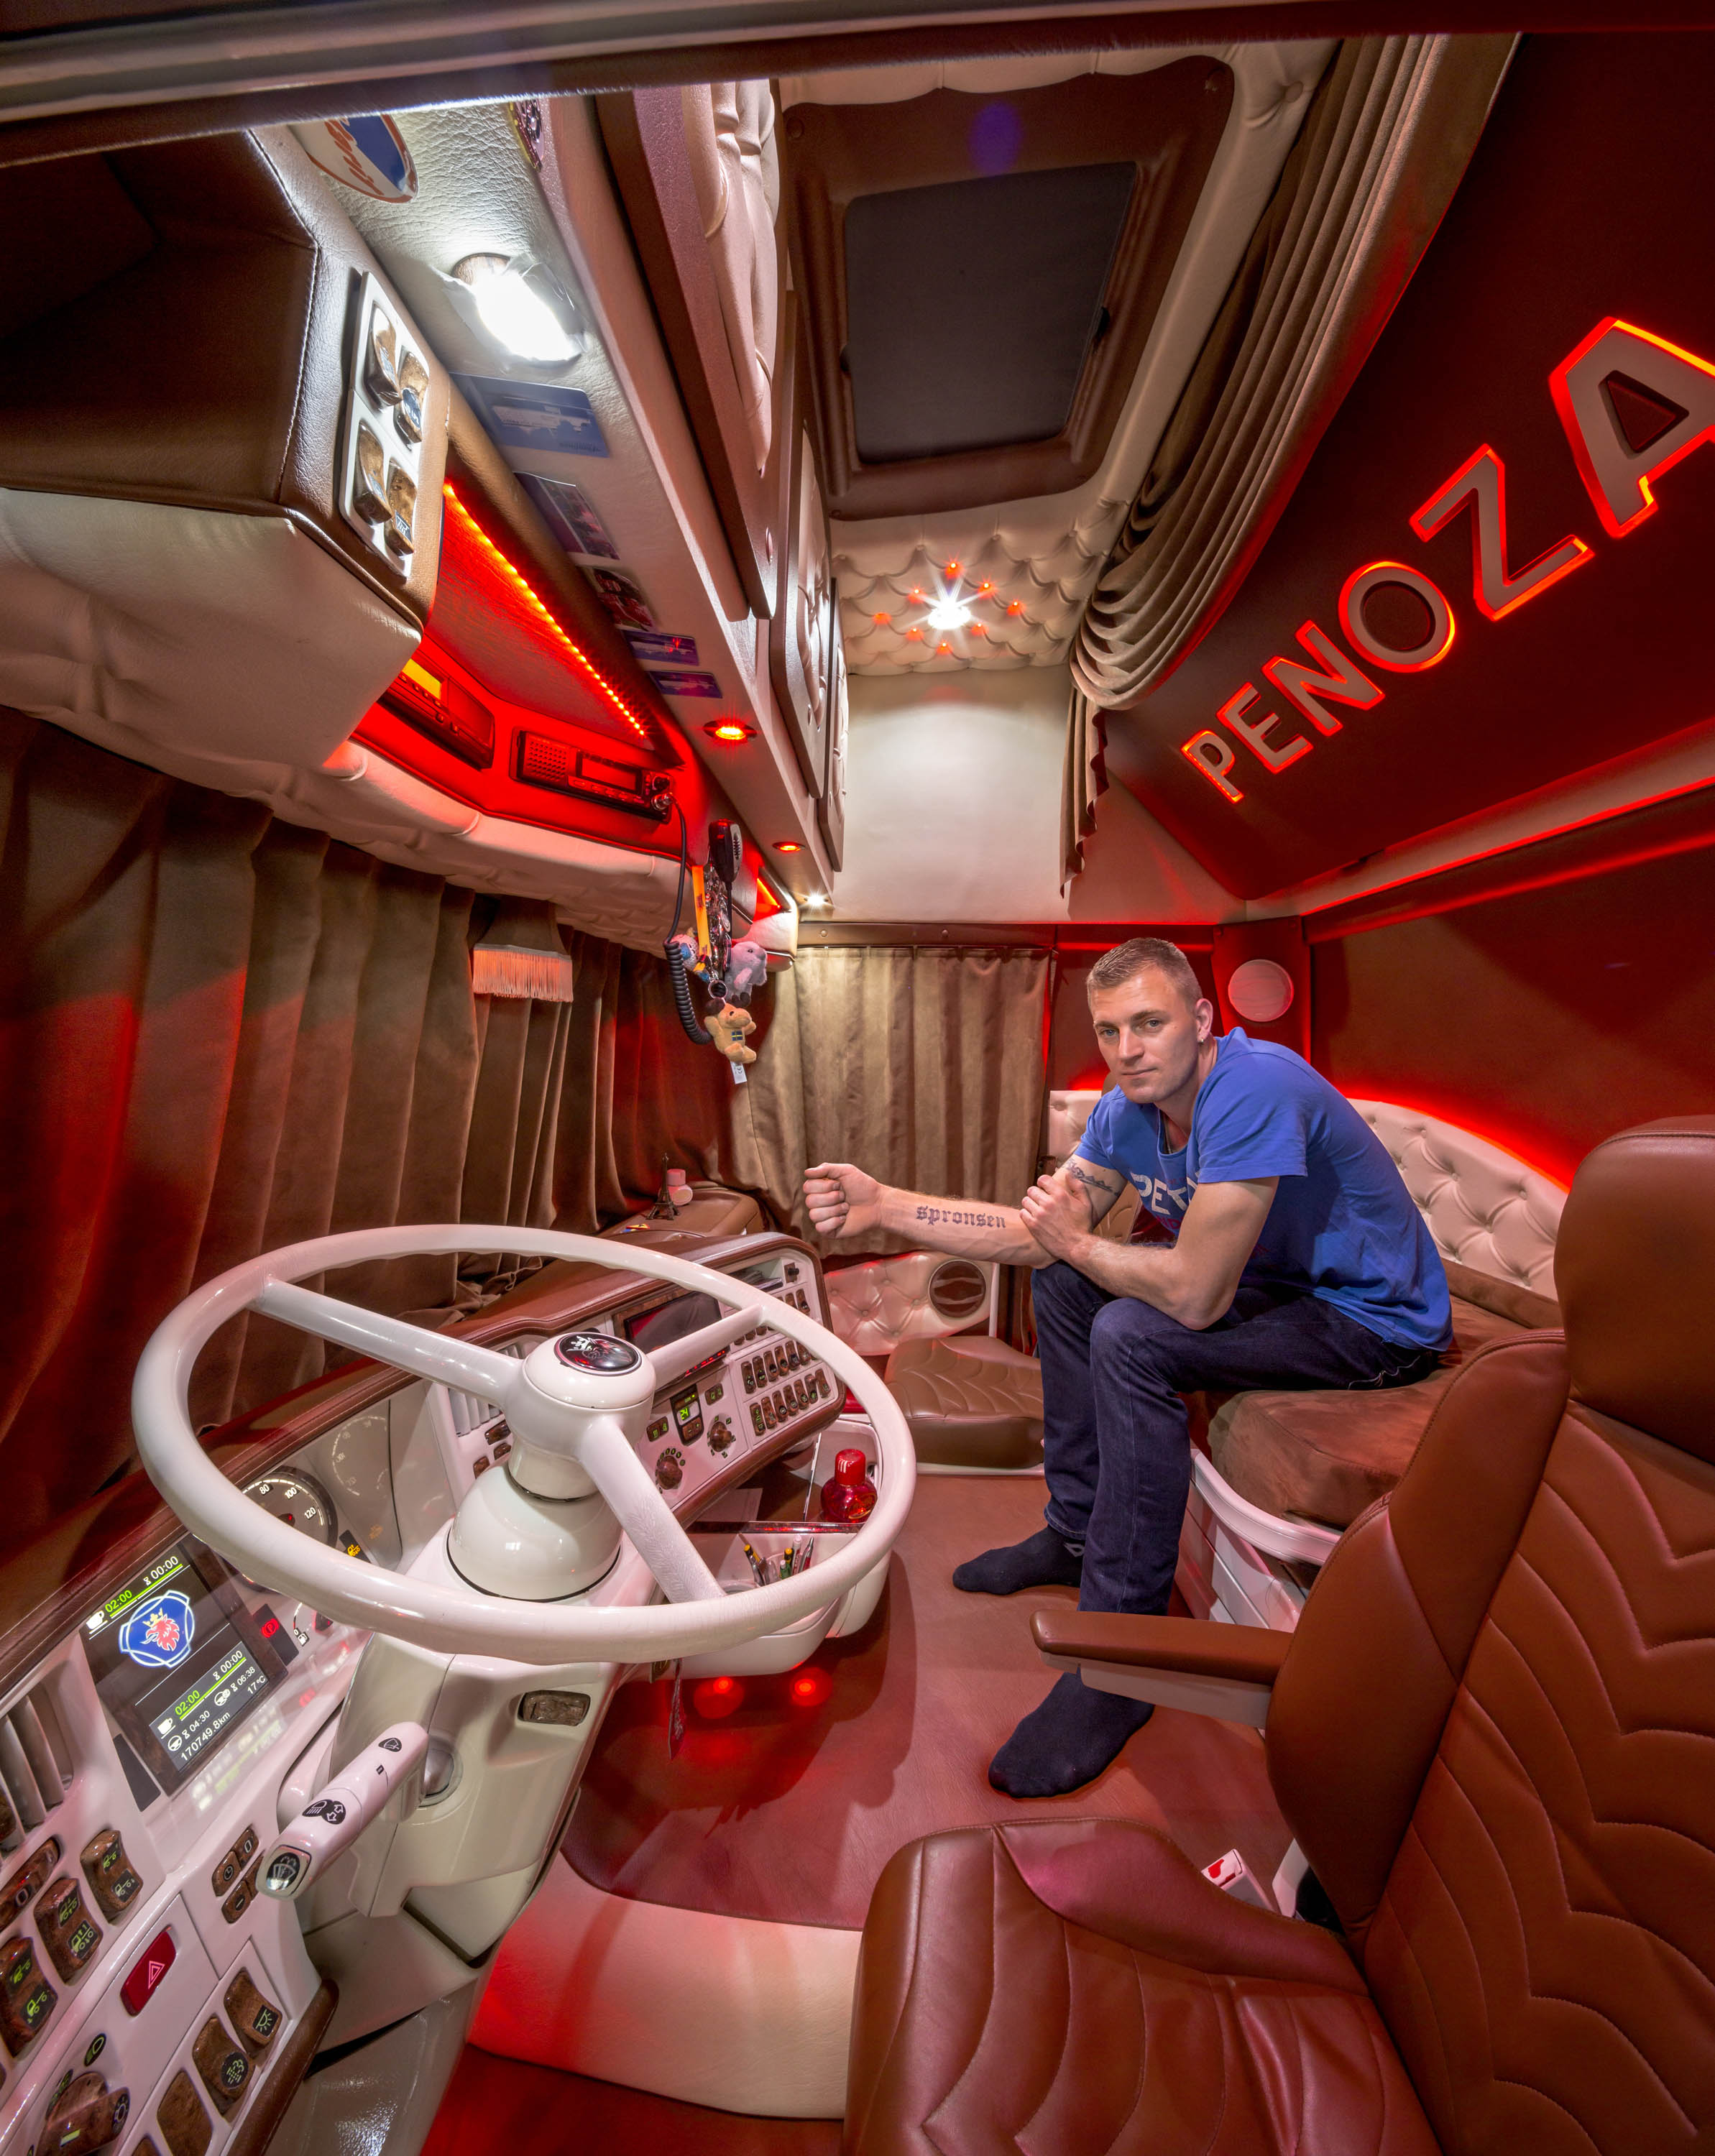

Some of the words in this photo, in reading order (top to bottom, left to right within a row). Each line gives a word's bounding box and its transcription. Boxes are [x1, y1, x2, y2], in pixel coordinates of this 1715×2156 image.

[1181, 315, 1715, 803] PENOZA
[259, 1483, 270, 1496] 80
[285, 1487, 298, 1499] 100
[304, 1506, 317, 1520] 120
[105, 1589, 132, 1613] 02:00
[150, 1556, 178, 1580] 00:00
[175, 1690, 200, 1715] 02:00
[220, 1650, 243, 1673] 00:00
[189, 1710, 210, 1732] 04:30
[236, 1666, 255, 1686] 06:38
